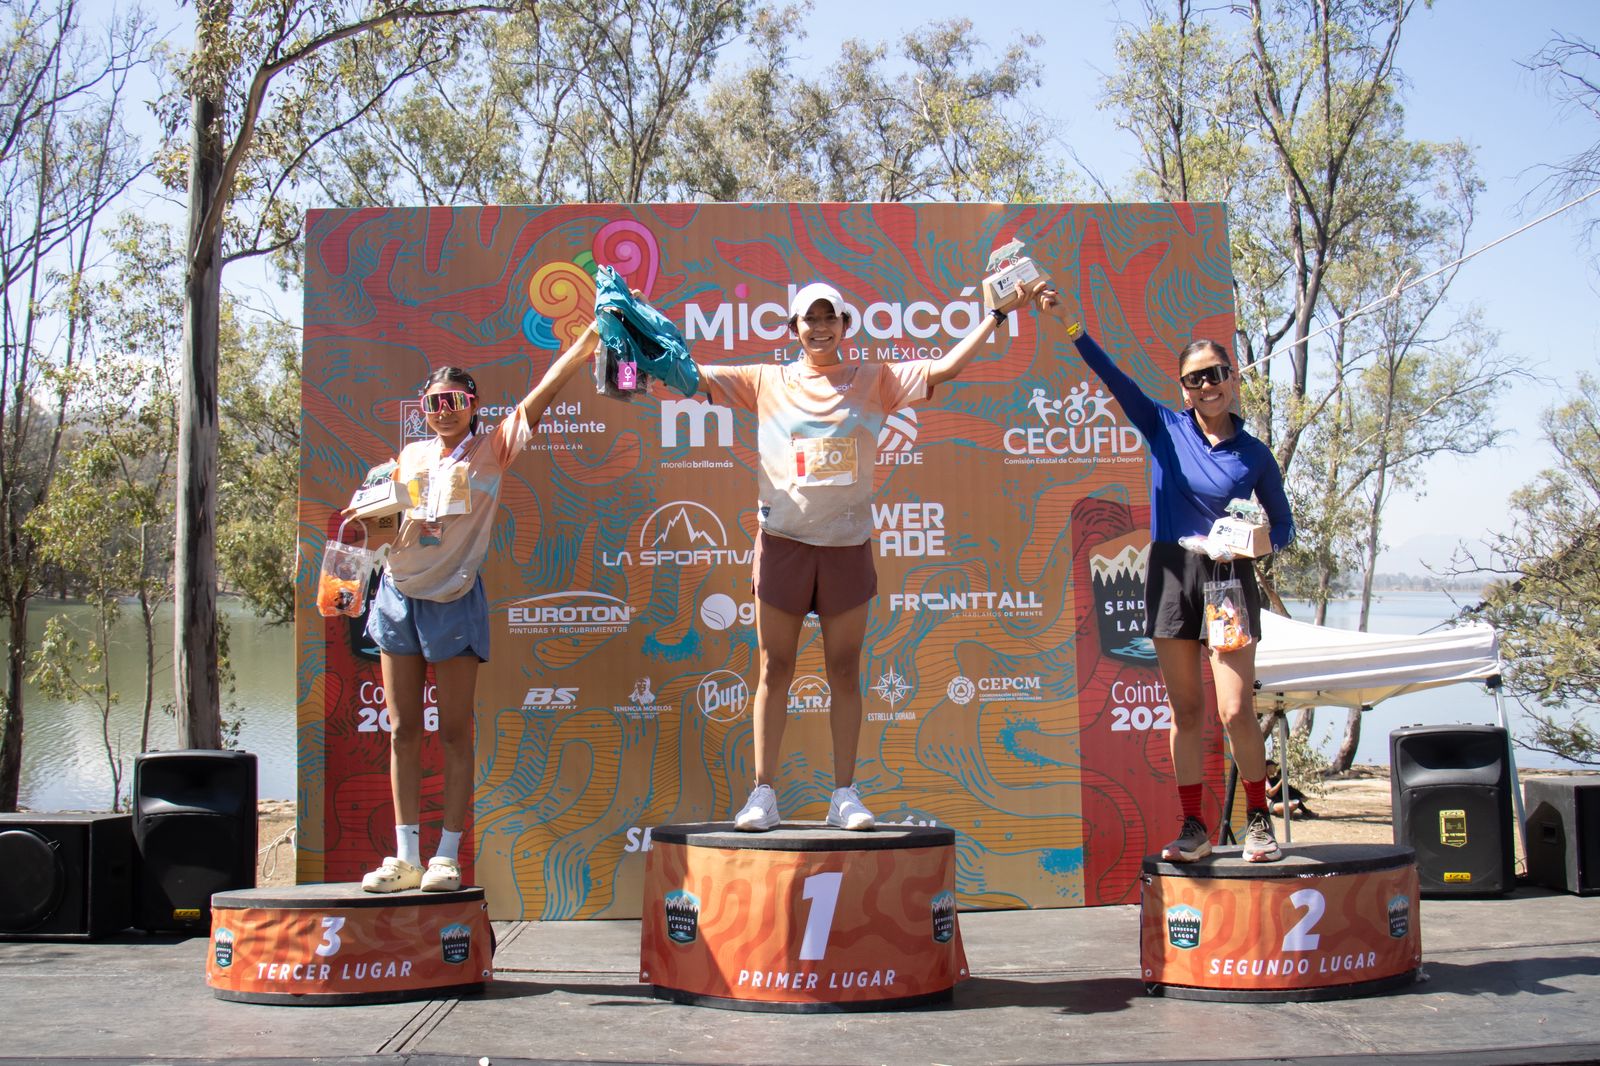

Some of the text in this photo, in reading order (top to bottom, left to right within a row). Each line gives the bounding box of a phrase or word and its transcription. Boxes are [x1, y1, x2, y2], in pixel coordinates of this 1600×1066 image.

[774, 349, 790, 361] EL
[849, 347, 869, 360] DE
[877, 345, 943, 360] MÉXICO
[555, 401, 582, 416] del
[537, 420, 606, 434] mbiente
[530, 443, 583, 451] MICHOACÁN
[1003, 426, 1143, 455] CECUFID
[874, 452, 923, 465] UFIDE
[1004, 457, 1035, 465] Comisión
[1035, 457, 1058, 465] Estatal
[1116, 456, 1143, 464] Deporte
[870, 502, 945, 530] WER
[880, 530, 946, 557] ADE
[602, 551, 633, 566] LA
[508, 605, 630, 622] EUROTON
[1105, 600, 1145, 615] SEND
[509, 627, 549, 635] PINTURAS
[977, 676, 1041, 691] CEPCM
[1112, 680, 1169, 703] Cointz
[523, 688, 580, 705] BS
[358, 706, 439, 732] 206
[867, 712, 894, 721] ESTRELLA
[1111, 705, 1172, 732] 202
[798, 872, 844, 961] 1
[1281, 888, 1326, 952] 2
[315, 916, 346, 957] 3
[257, 960, 413, 980] TERCER LUGAR
[1209, 951, 1376, 976] SEGUNDO LUGAR
[737, 968, 897, 990] PRIMER LUGAR
